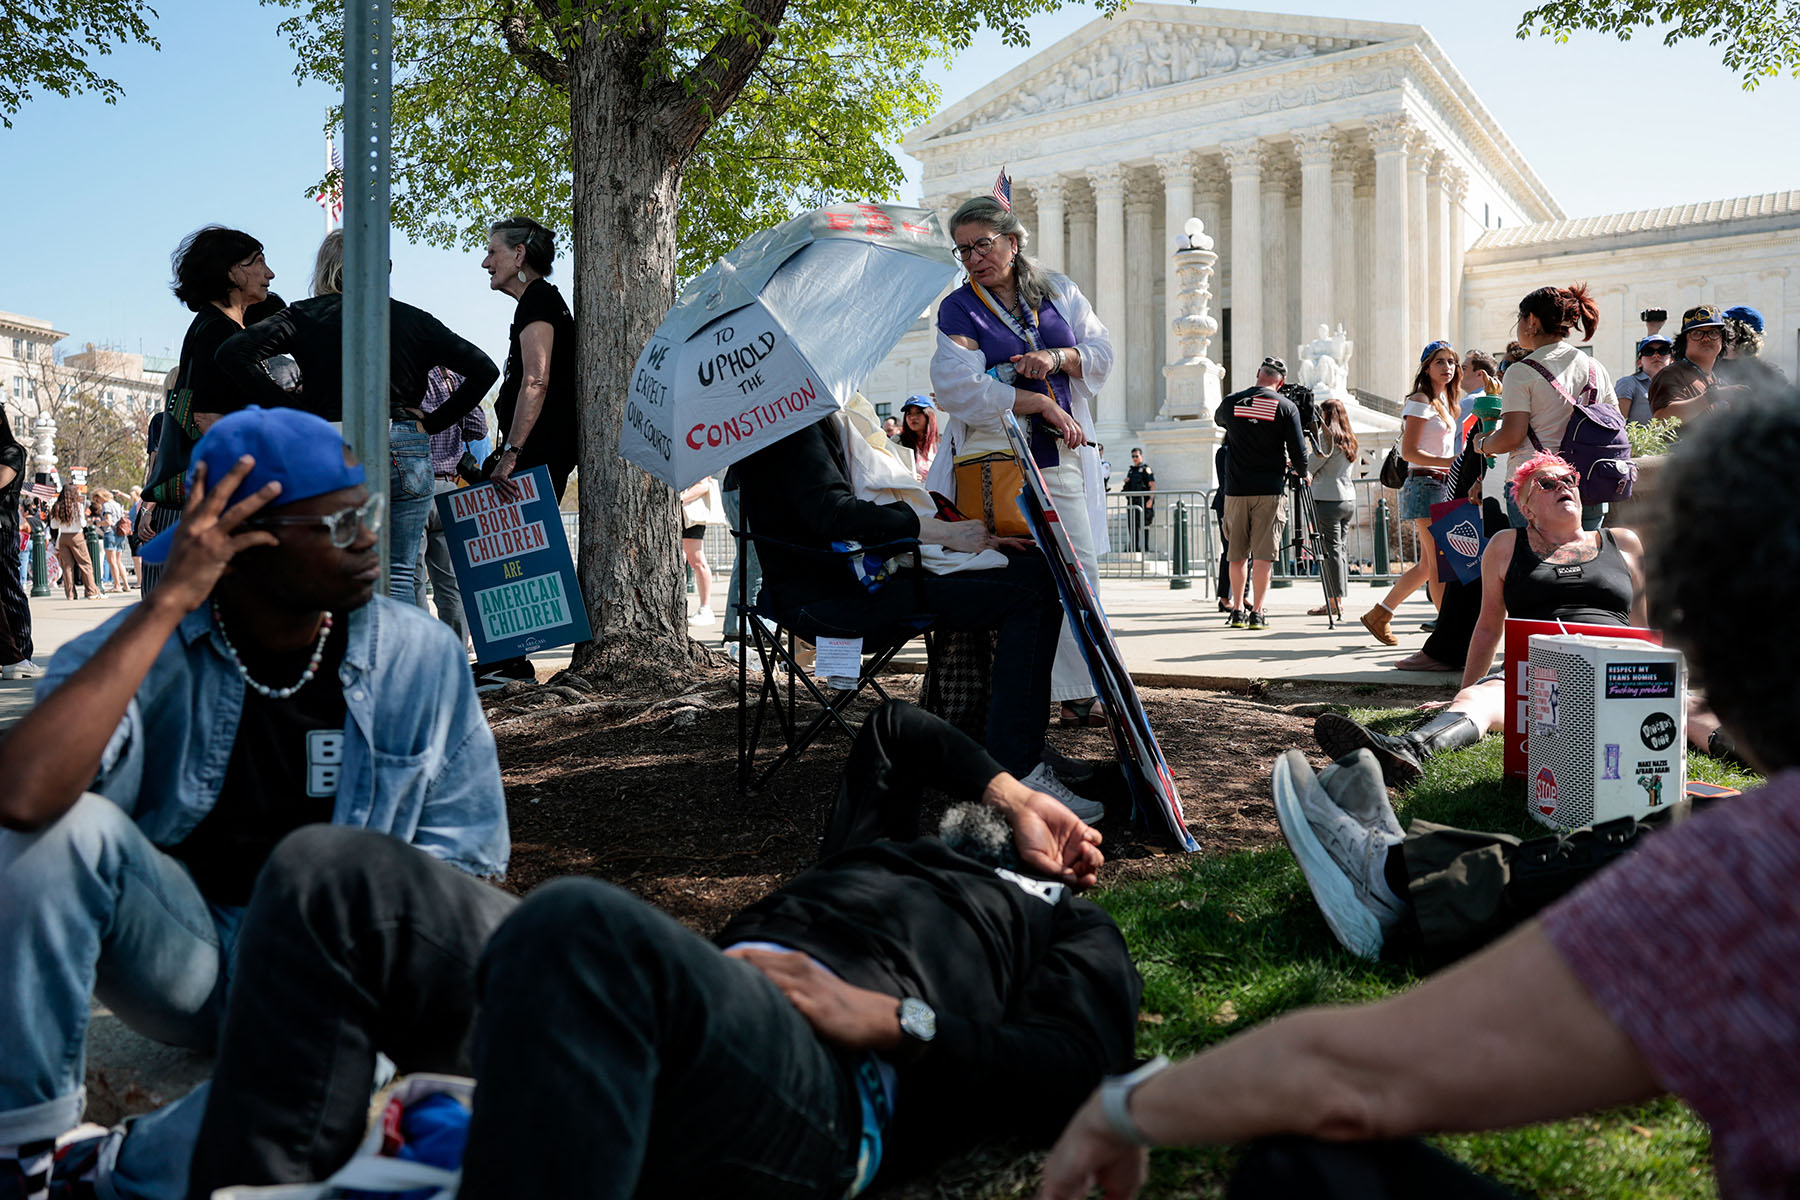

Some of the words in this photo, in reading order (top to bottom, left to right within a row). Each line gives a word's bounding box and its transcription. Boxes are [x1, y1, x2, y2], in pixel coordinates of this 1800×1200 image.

[713, 327, 734, 346] TO
[647, 344, 670, 371] WE
[698, 331, 775, 387] UPHOLD
[636, 368, 667, 407] EXPECT
[738, 369, 765, 395] THE
[628, 401, 643, 434] OUR
[644, 419, 672, 461] COURTS
[686, 378, 816, 450] CONSTUTION
[454, 476, 535, 518] AMERAN
[478, 505, 522, 536] BORN
[468, 524, 545, 563] CHILDREN
[504, 560, 523, 579] ARE
[480, 575, 560, 615] AMERICAN
[488, 600, 564, 637] CHILDREN
[1609, 685, 1638, 696] Fucking
[1638, 685, 1668, 696] problem
[1536, 779, 1557, 800] STOP
